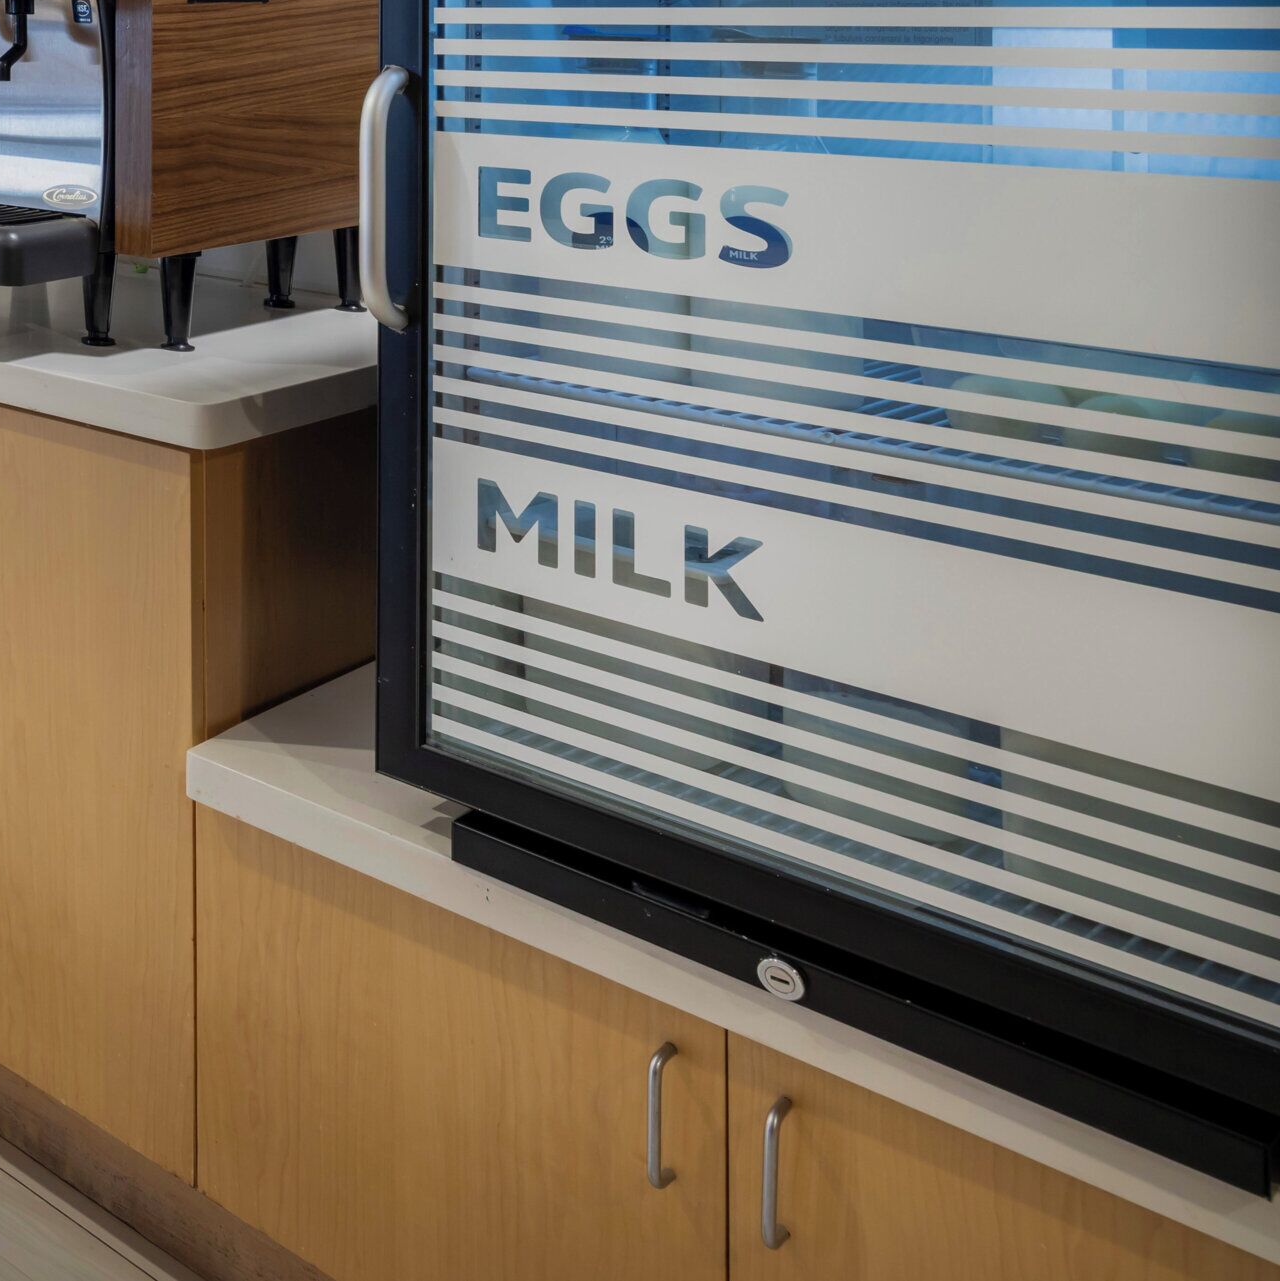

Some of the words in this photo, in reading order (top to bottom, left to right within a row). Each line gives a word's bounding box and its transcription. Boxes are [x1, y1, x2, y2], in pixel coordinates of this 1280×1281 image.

[477, 165, 794, 269] EGGS
[728, 250, 758, 261] MILK
[476, 477, 766, 623] MILK
